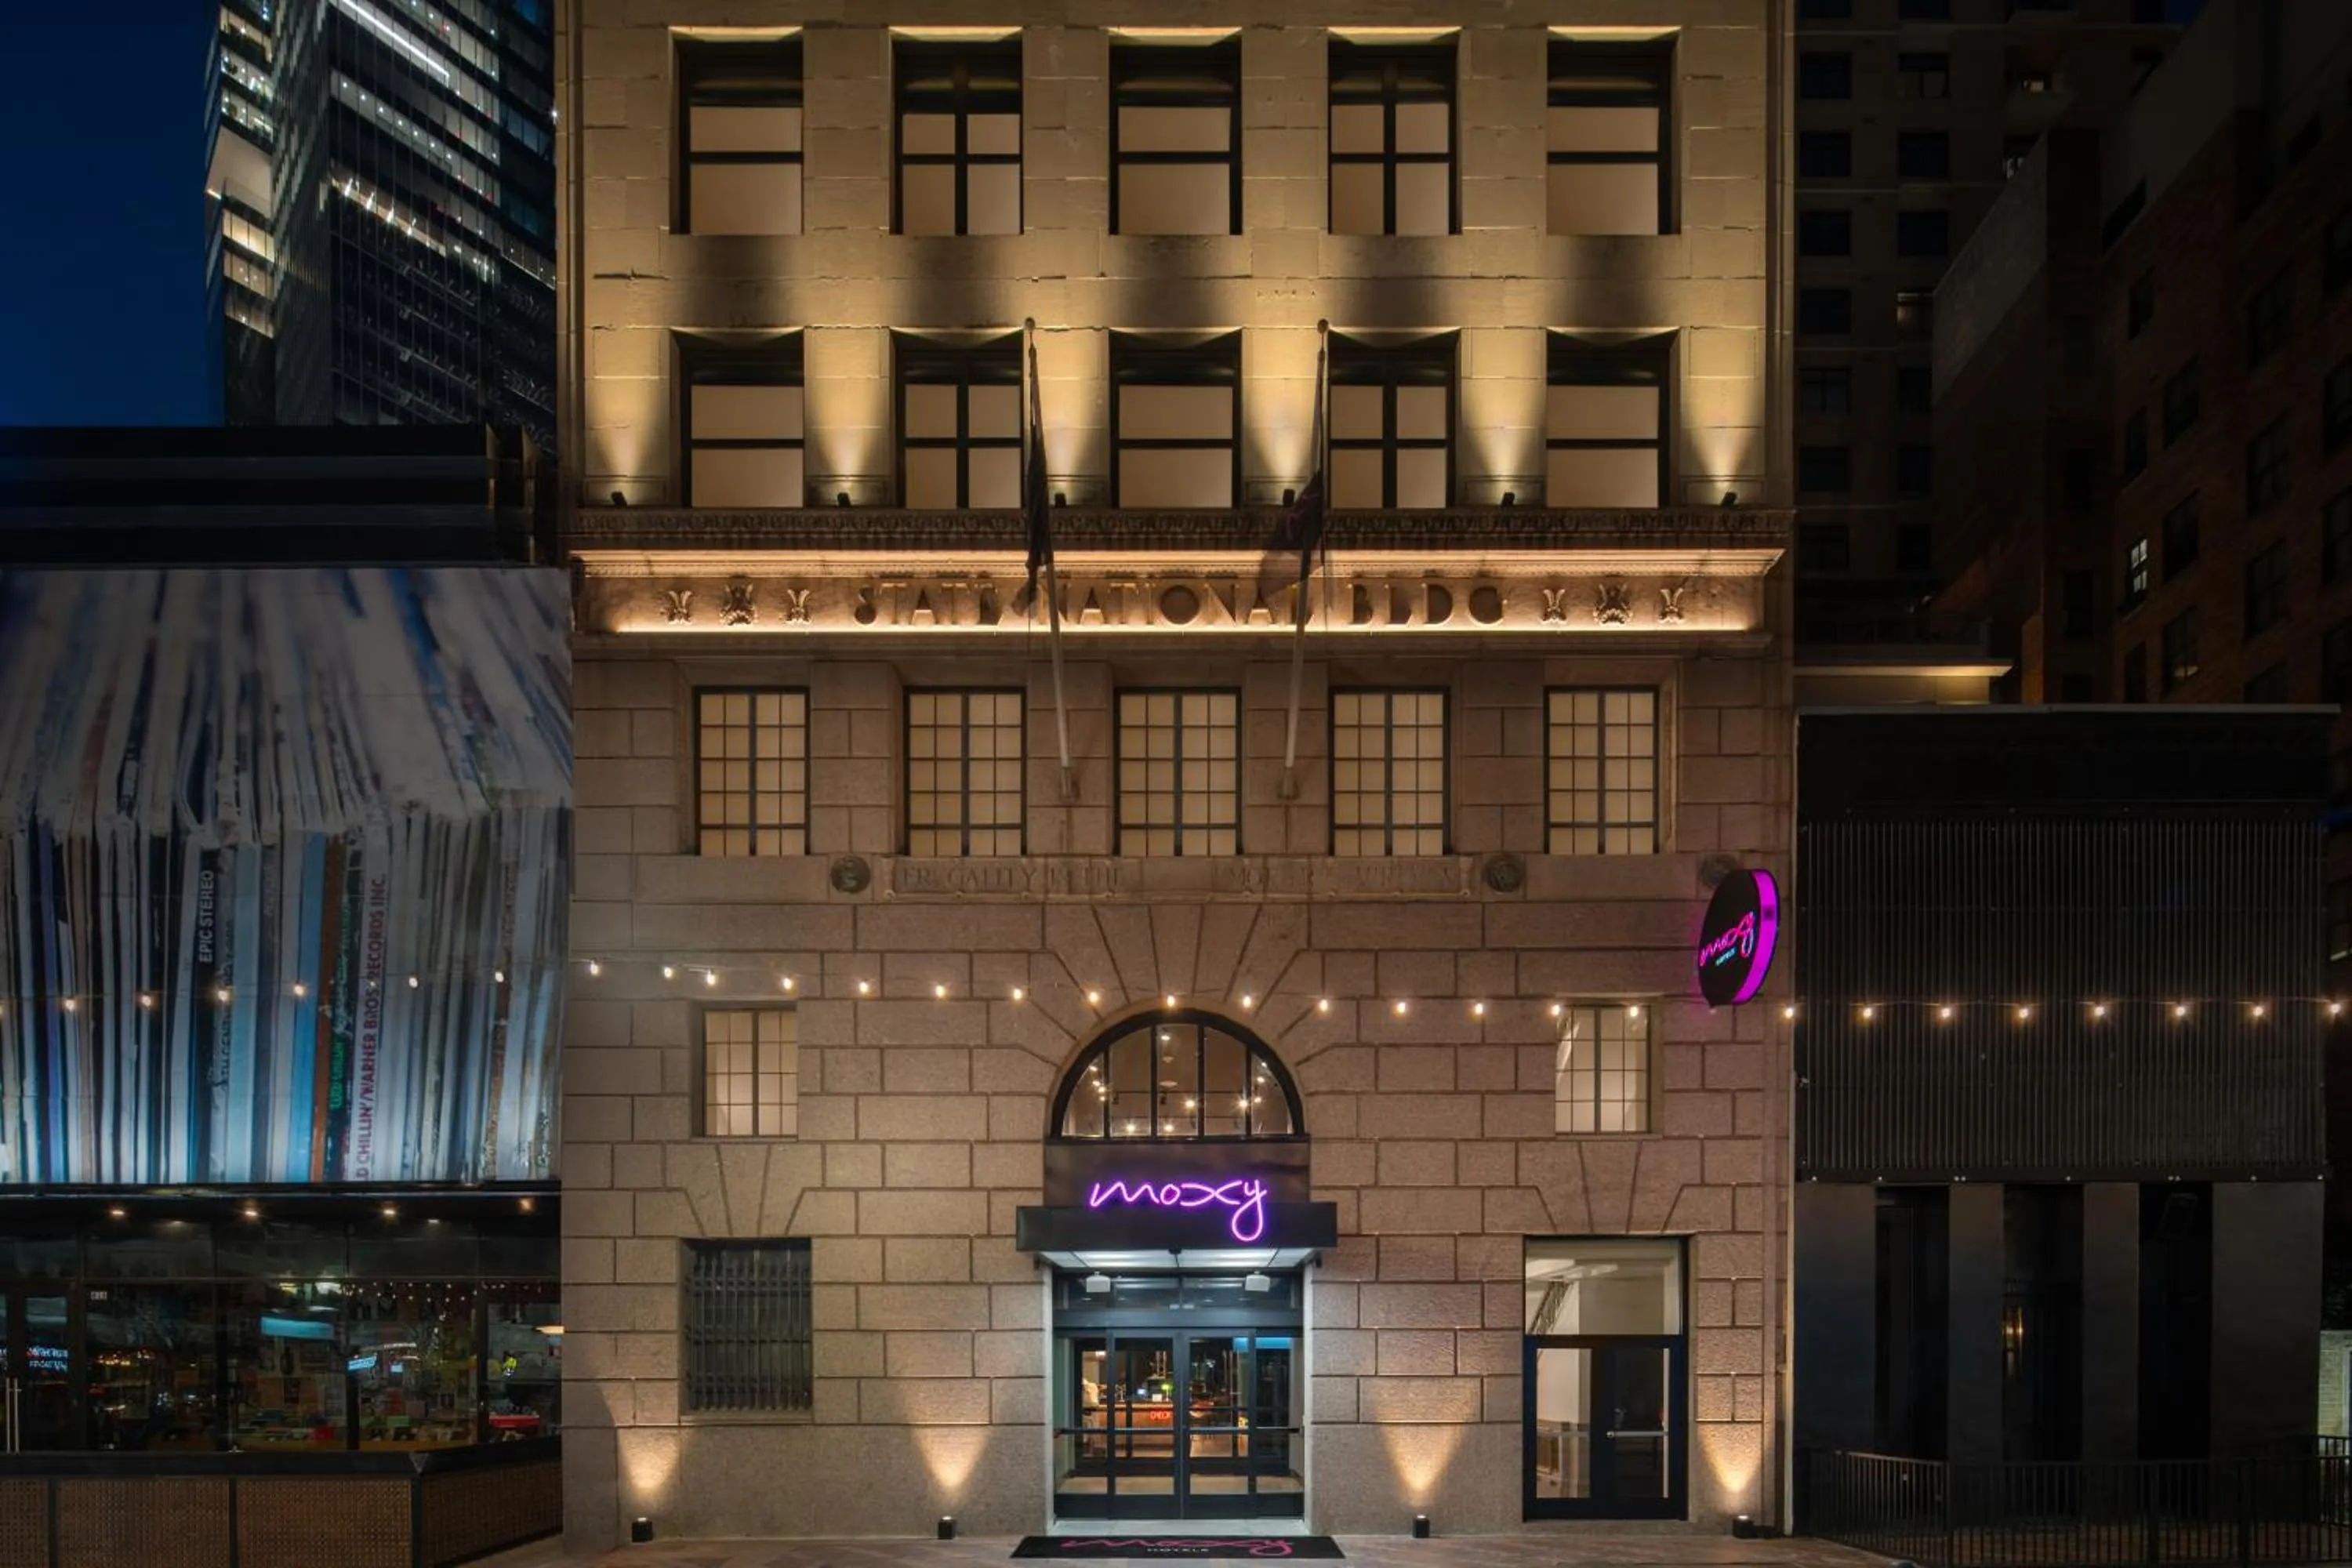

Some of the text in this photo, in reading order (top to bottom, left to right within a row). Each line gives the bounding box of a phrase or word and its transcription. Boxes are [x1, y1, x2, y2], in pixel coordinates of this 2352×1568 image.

[854, 583, 1004, 626] STATE
[1345, 583, 1506, 626] BLDG
[198, 870, 214, 963] EPIC STEREO
[370, 873, 387, 907] INC.
[365, 910, 384, 979] RECORDS
[1090, 1179, 1267, 1242] moxy
